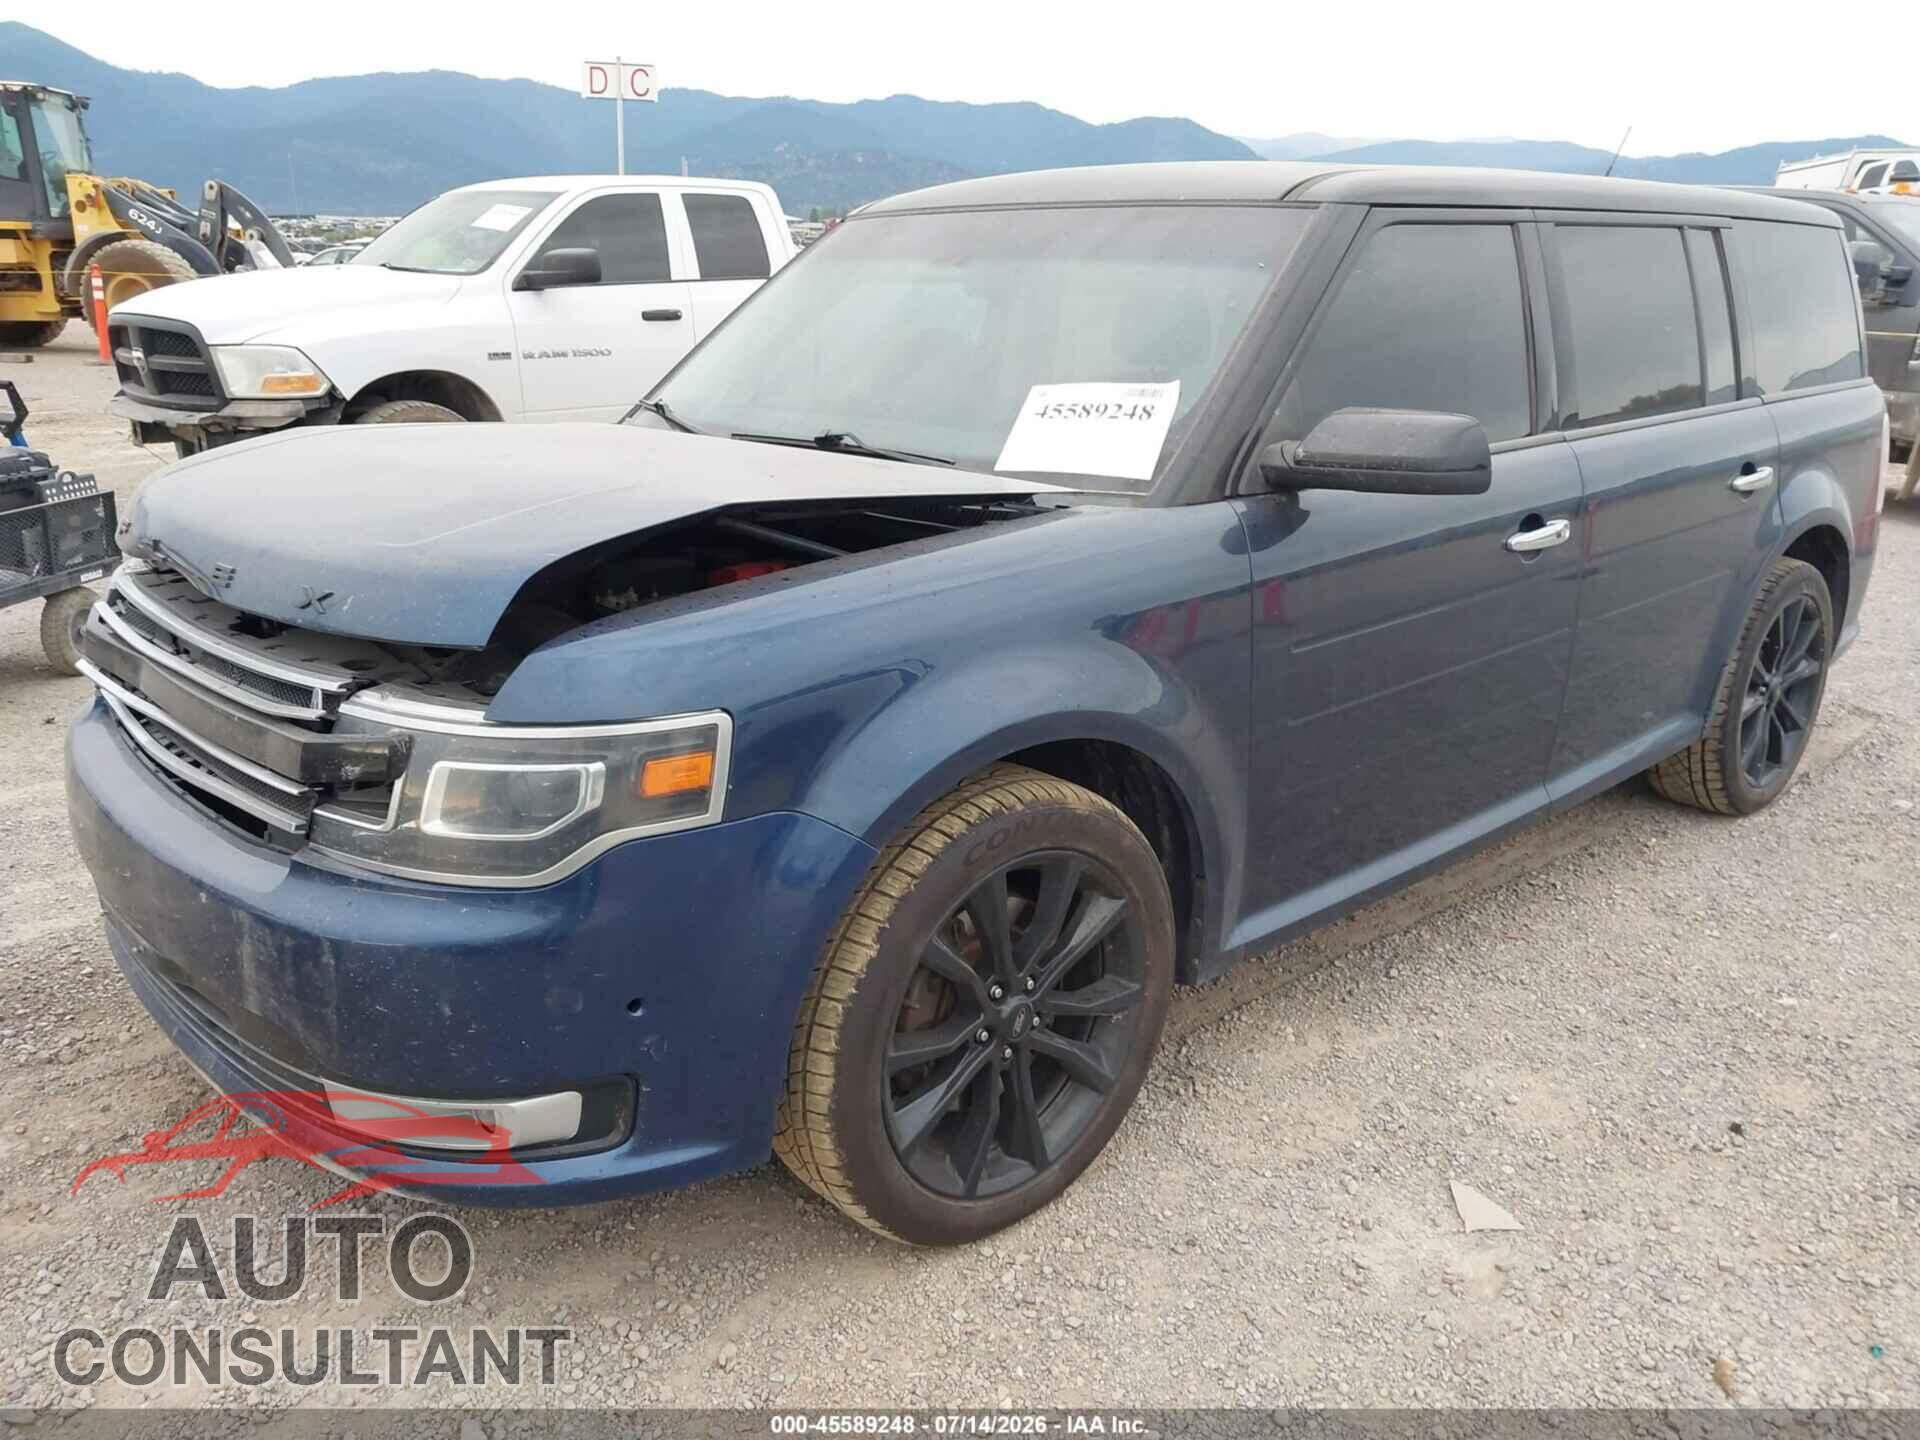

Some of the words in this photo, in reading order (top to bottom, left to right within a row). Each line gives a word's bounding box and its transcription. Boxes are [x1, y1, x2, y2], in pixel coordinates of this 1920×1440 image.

[589, 66, 608, 95] D
[630, 68, 649, 97] C
[128, 208, 162, 234] 624J
[1035, 403, 1155, 420] 45589248
